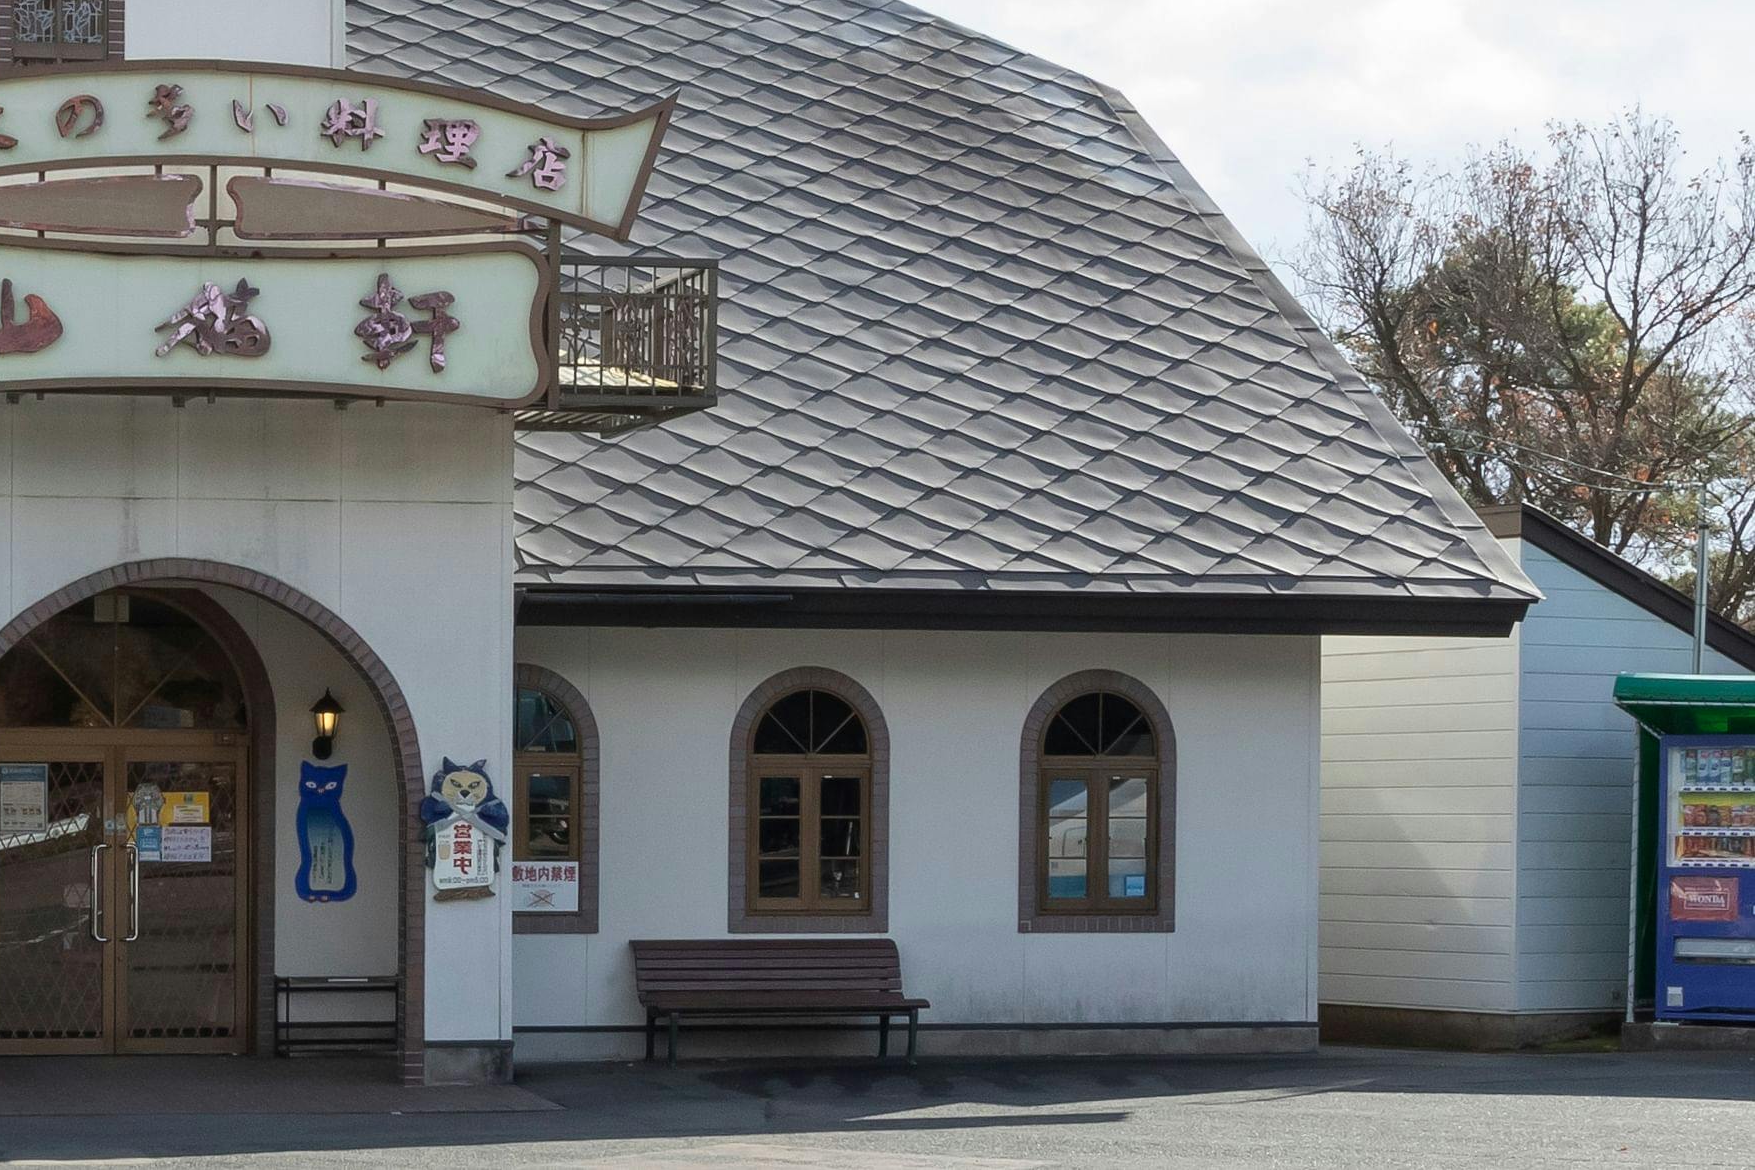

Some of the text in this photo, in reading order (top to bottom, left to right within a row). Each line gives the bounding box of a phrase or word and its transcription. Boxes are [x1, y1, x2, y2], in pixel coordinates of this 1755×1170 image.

[453, 824, 473, 875] 営業中
[512, 864, 577, 883] 敷地内禁煙
